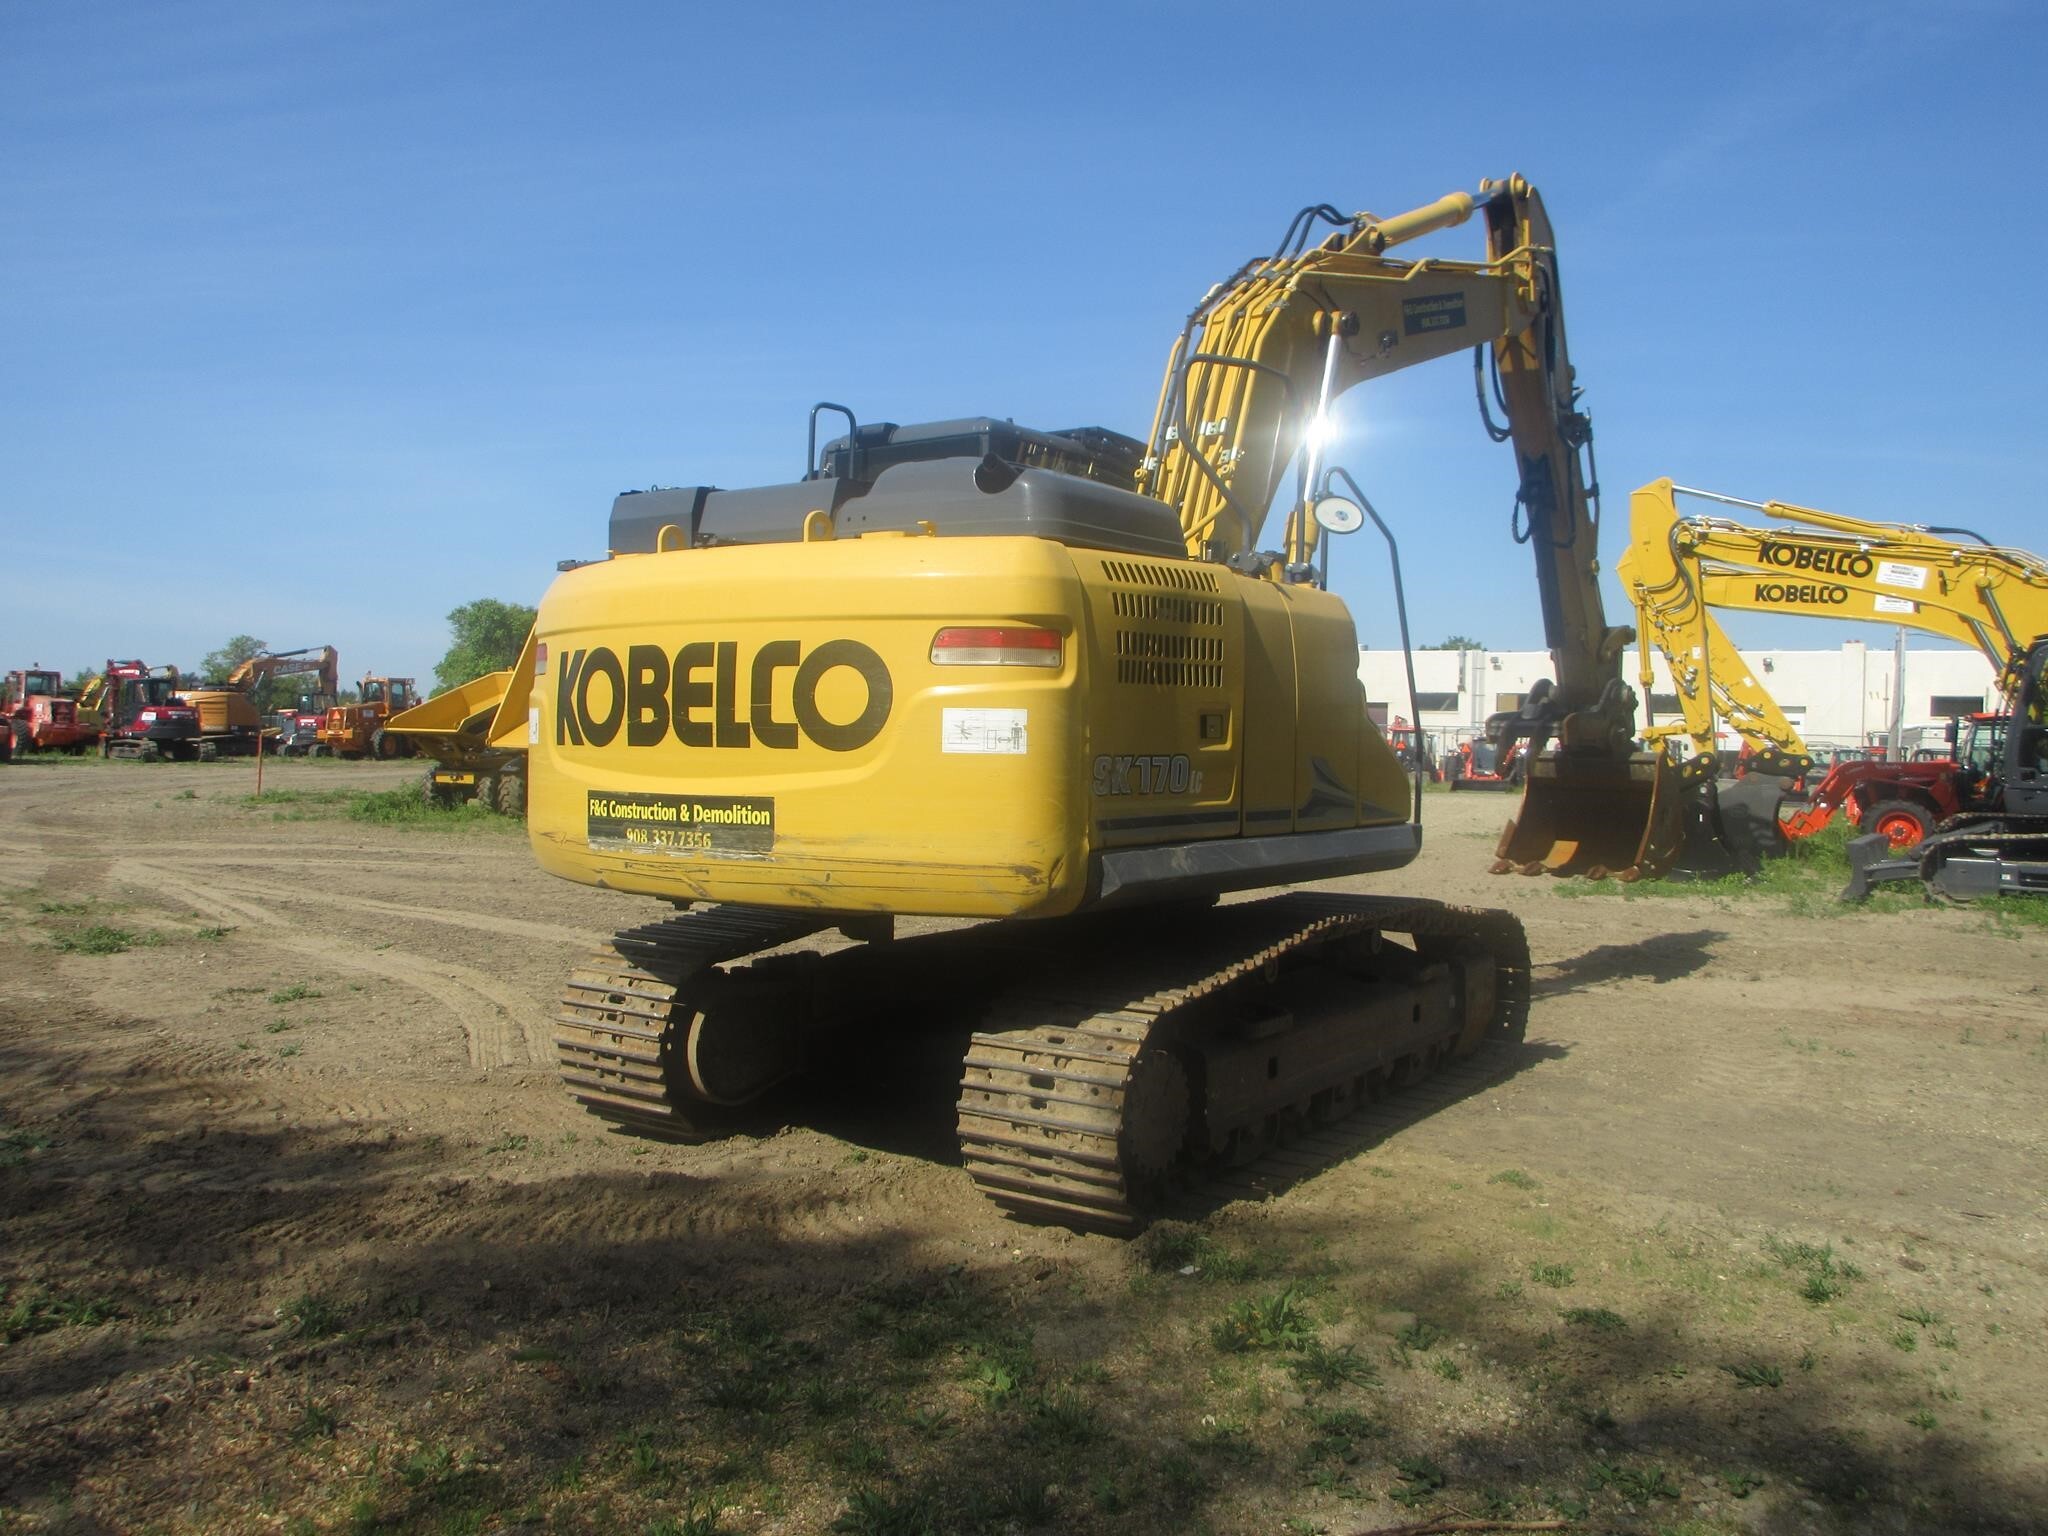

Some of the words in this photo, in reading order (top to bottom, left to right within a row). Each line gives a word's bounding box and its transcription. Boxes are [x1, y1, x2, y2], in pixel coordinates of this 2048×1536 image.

[1758, 541, 1874, 579] KOBELCO
[1754, 583, 1848, 604] KOBELCO
[273, 662, 302, 673] CASE
[556, 638, 894, 752] KOBELCO
[589, 799, 608, 817] F&G
[609, 800, 677, 822] Construction
[680, 803, 690, 822] &
[693, 804, 771, 825] Demolition
